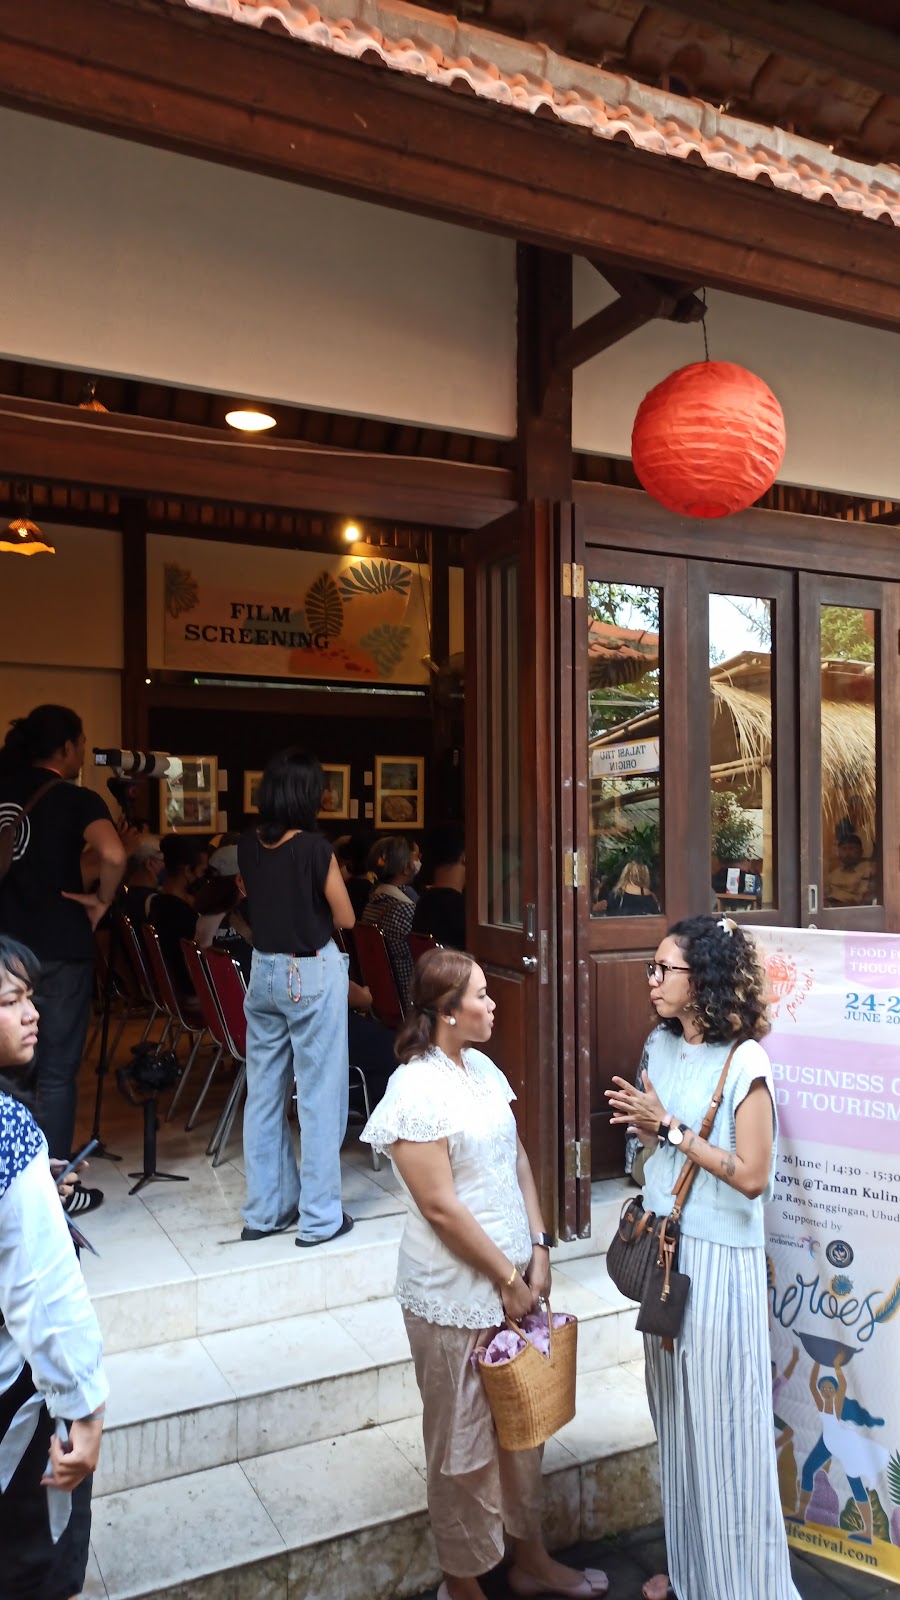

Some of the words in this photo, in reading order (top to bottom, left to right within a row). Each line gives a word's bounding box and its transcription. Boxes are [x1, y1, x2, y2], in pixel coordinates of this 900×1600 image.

[230, 602, 290, 624] FILM
[184, 623, 329, 650] SCREENING
[850, 947, 886, 959] FOOD
[850, 961, 900, 975] THOUG
[844, 1011, 881, 1023] JUNE
[771, 1062, 884, 1094] BUSINESS
[797, 1091, 900, 1121] TOURISM
[783, 1154, 793, 1164] 26
[795, 1155, 821, 1169] June
[832, 1164, 861, 1176] 14:30
[873, 1170, 900, 1183] 15:30
[774, 1171, 800, 1187] Kayu
[802, 1178, 858, 1197] @Taman
[862, 1187, 900, 1203] Kulin
[786, 1193, 806, 1206] Raya
[808, 1199, 868, 1218] Sanggingan,
[782, 1211, 828, 1229] Supported
[831, 1220, 843, 1232] by
